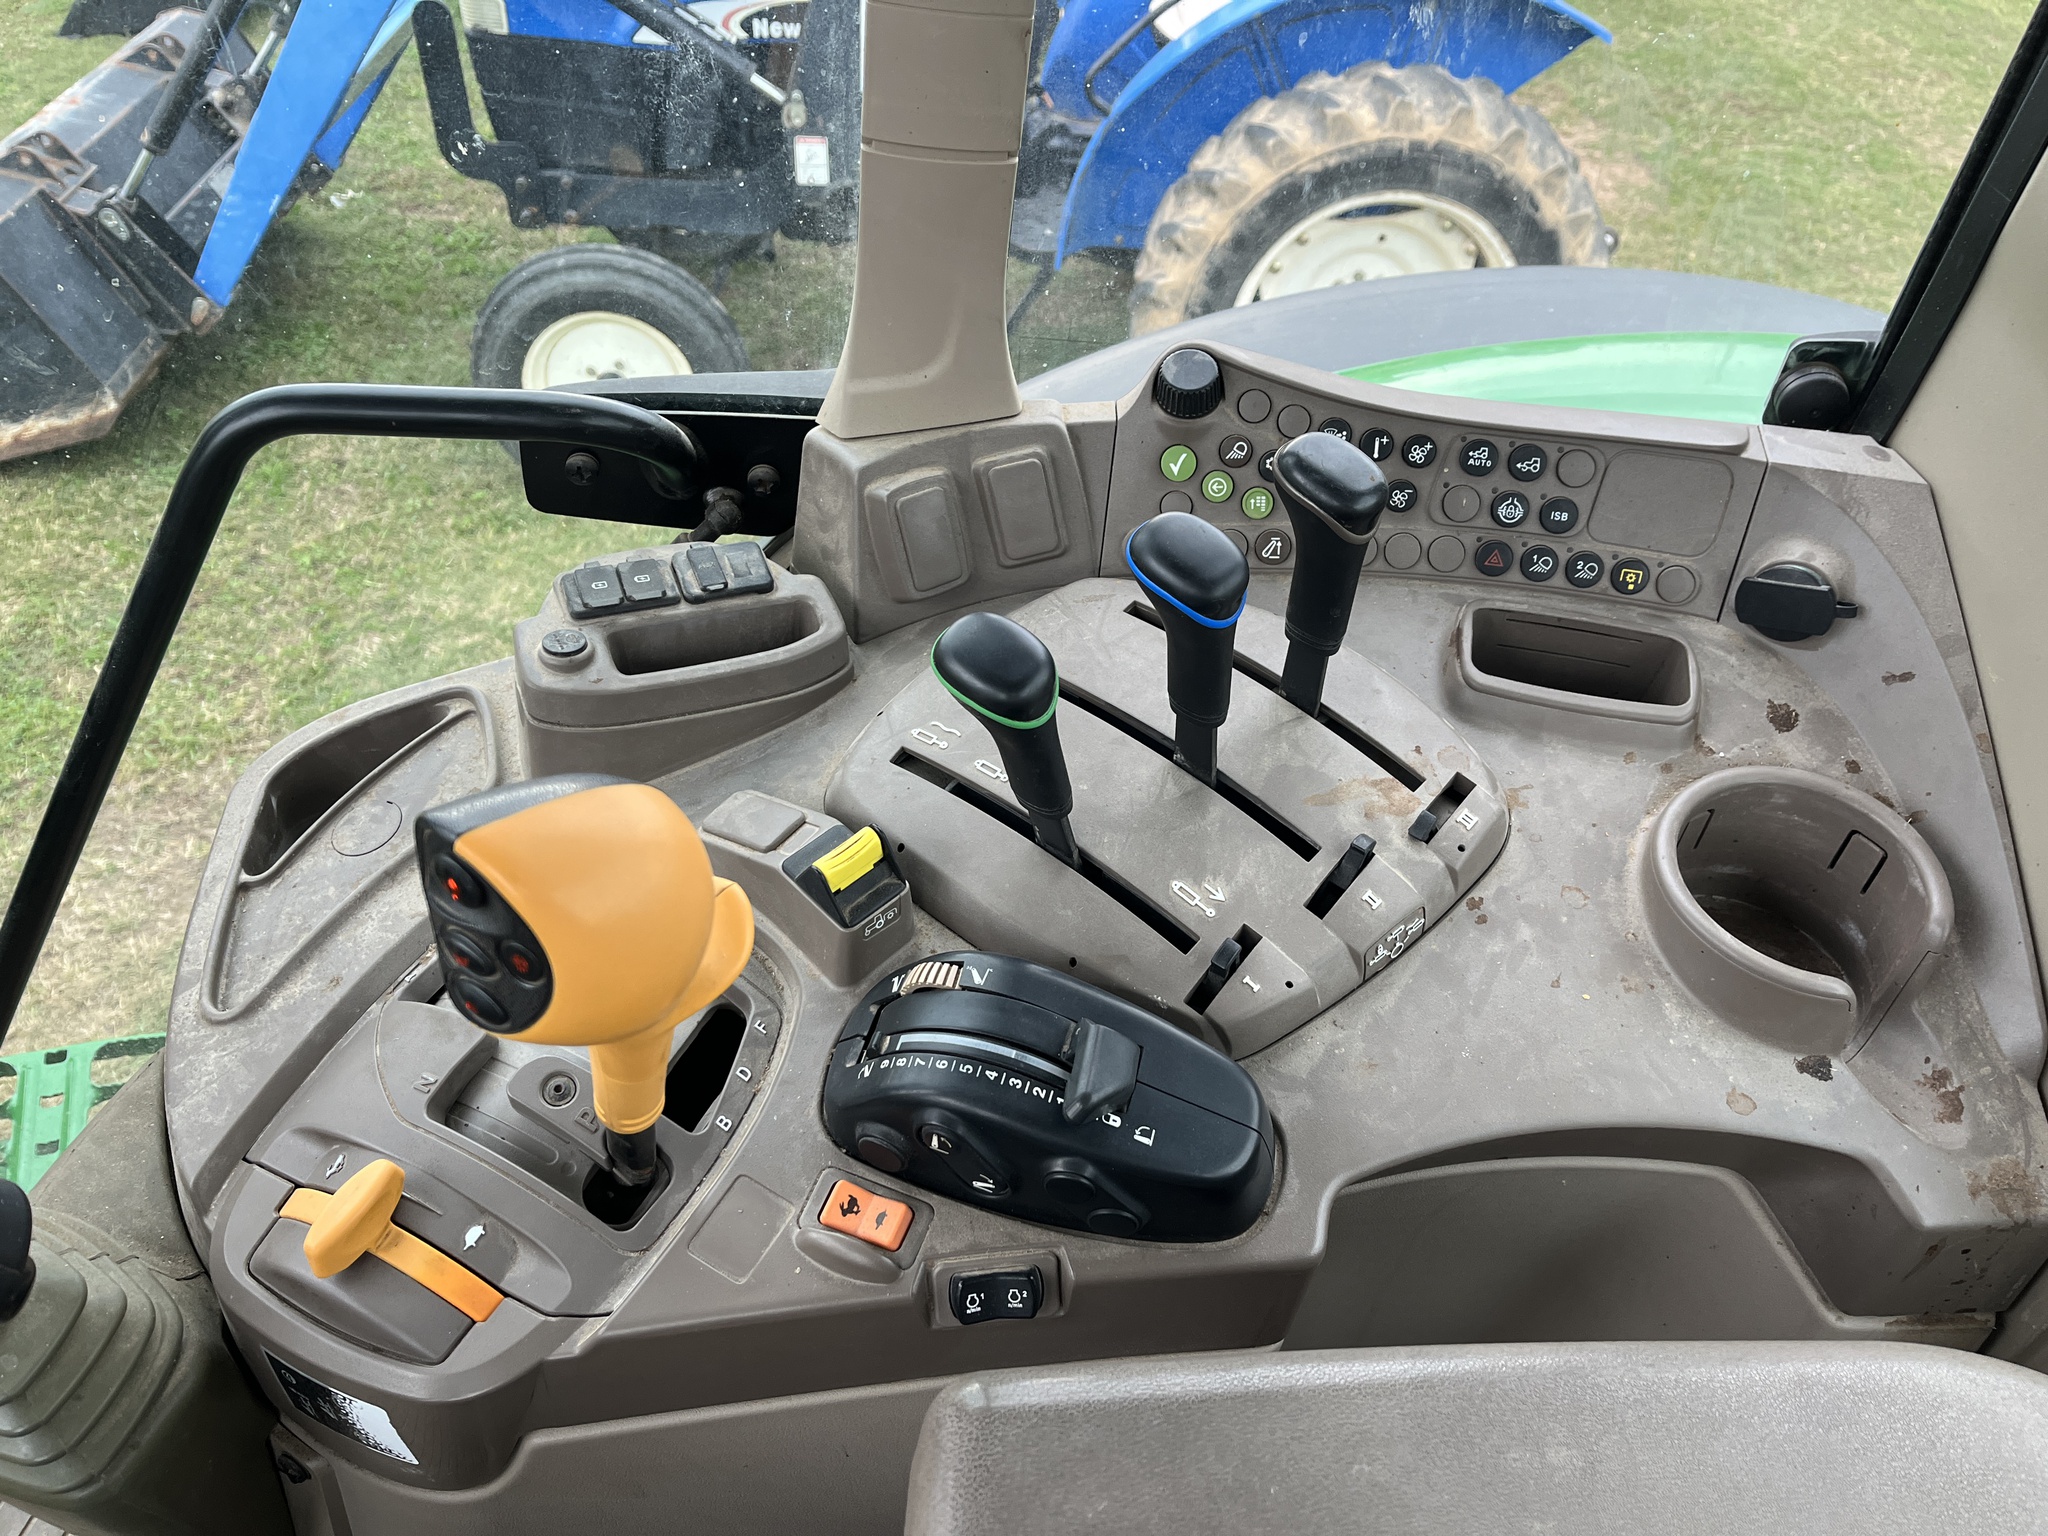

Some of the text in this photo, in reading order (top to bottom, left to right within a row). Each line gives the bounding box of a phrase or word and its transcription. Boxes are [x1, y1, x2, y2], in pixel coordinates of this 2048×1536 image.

[752, 18, 801, 39] New
[1468, 458, 1492, 467] AUTO
[1550, 511, 1569, 522] ISB
[1532, 554, 1538, 563] 1
[1576, 561, 1584, 570] 2
[1456, 808, 1479, 831] III
[1362, 890, 1383, 911] II
[1242, 974, 1261, 993] I
[753, 1019, 767, 1034] F
[735, 1066, 752, 1082] D
[880, 1060, 890, 1069] 9
[896, 1057, 907, 1067] 8
[914, 1057, 926, 1067] 7
[935, 1060, 949, 1069] 6
[958, 1064, 974, 1074] 5
[985, 1070, 999, 1081] 4
[1009, 1077, 1023, 1089] 3
[1032, 1086, 1047, 1099] 2
[412, 1073, 439, 1094] N
[574, 1106, 598, 1134] P
[715, 1115, 733, 1132] B
[1022, 1290, 1027, 1298] 2
